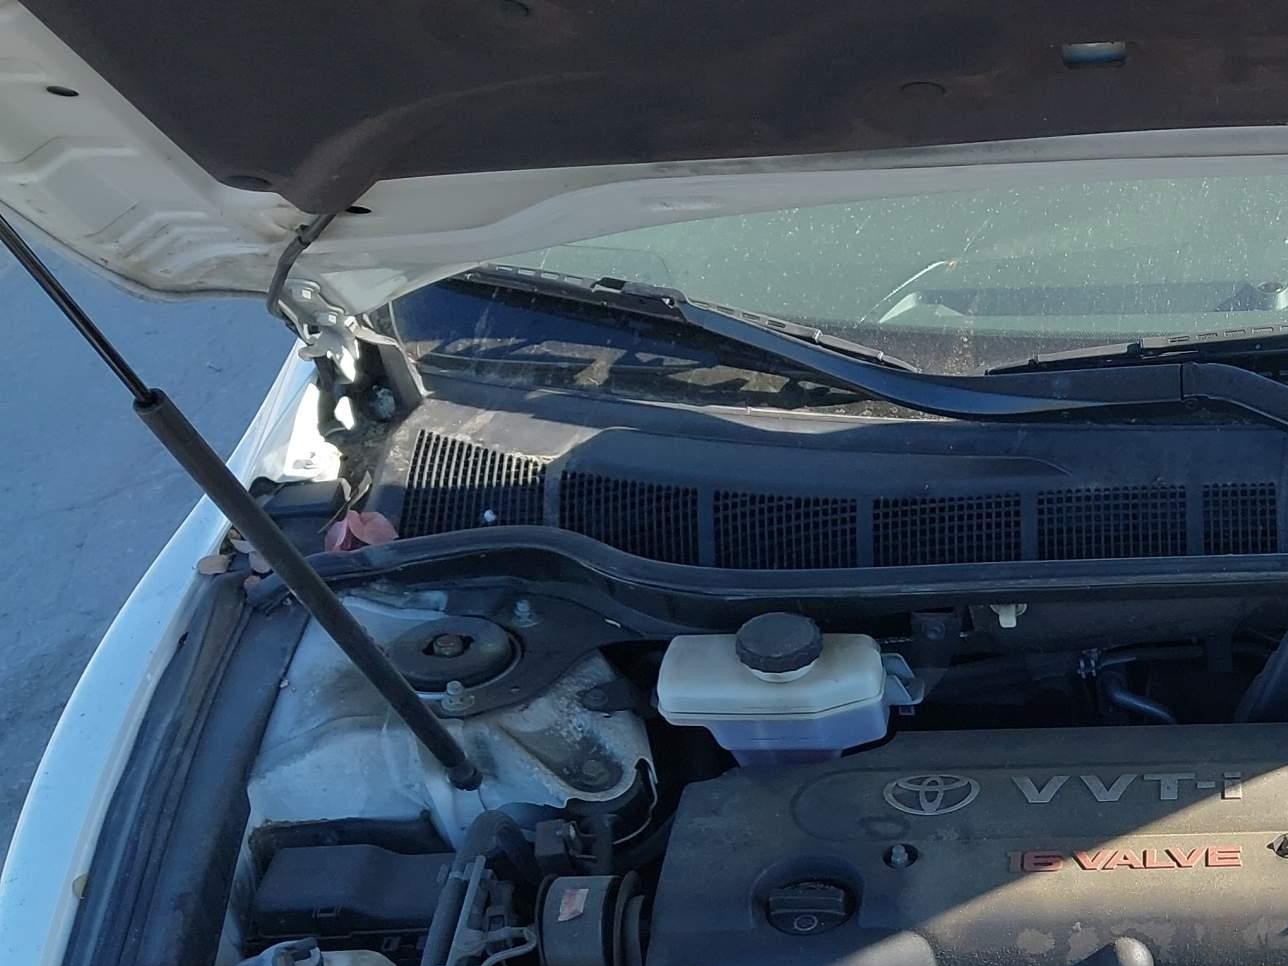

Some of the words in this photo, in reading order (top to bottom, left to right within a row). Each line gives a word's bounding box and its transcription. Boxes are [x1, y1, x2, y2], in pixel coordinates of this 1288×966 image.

[1011, 772, 1242, 803] VVT-i
[1008, 850, 1064, 873] 16
[1072, 845, 1242, 872] VALVE
